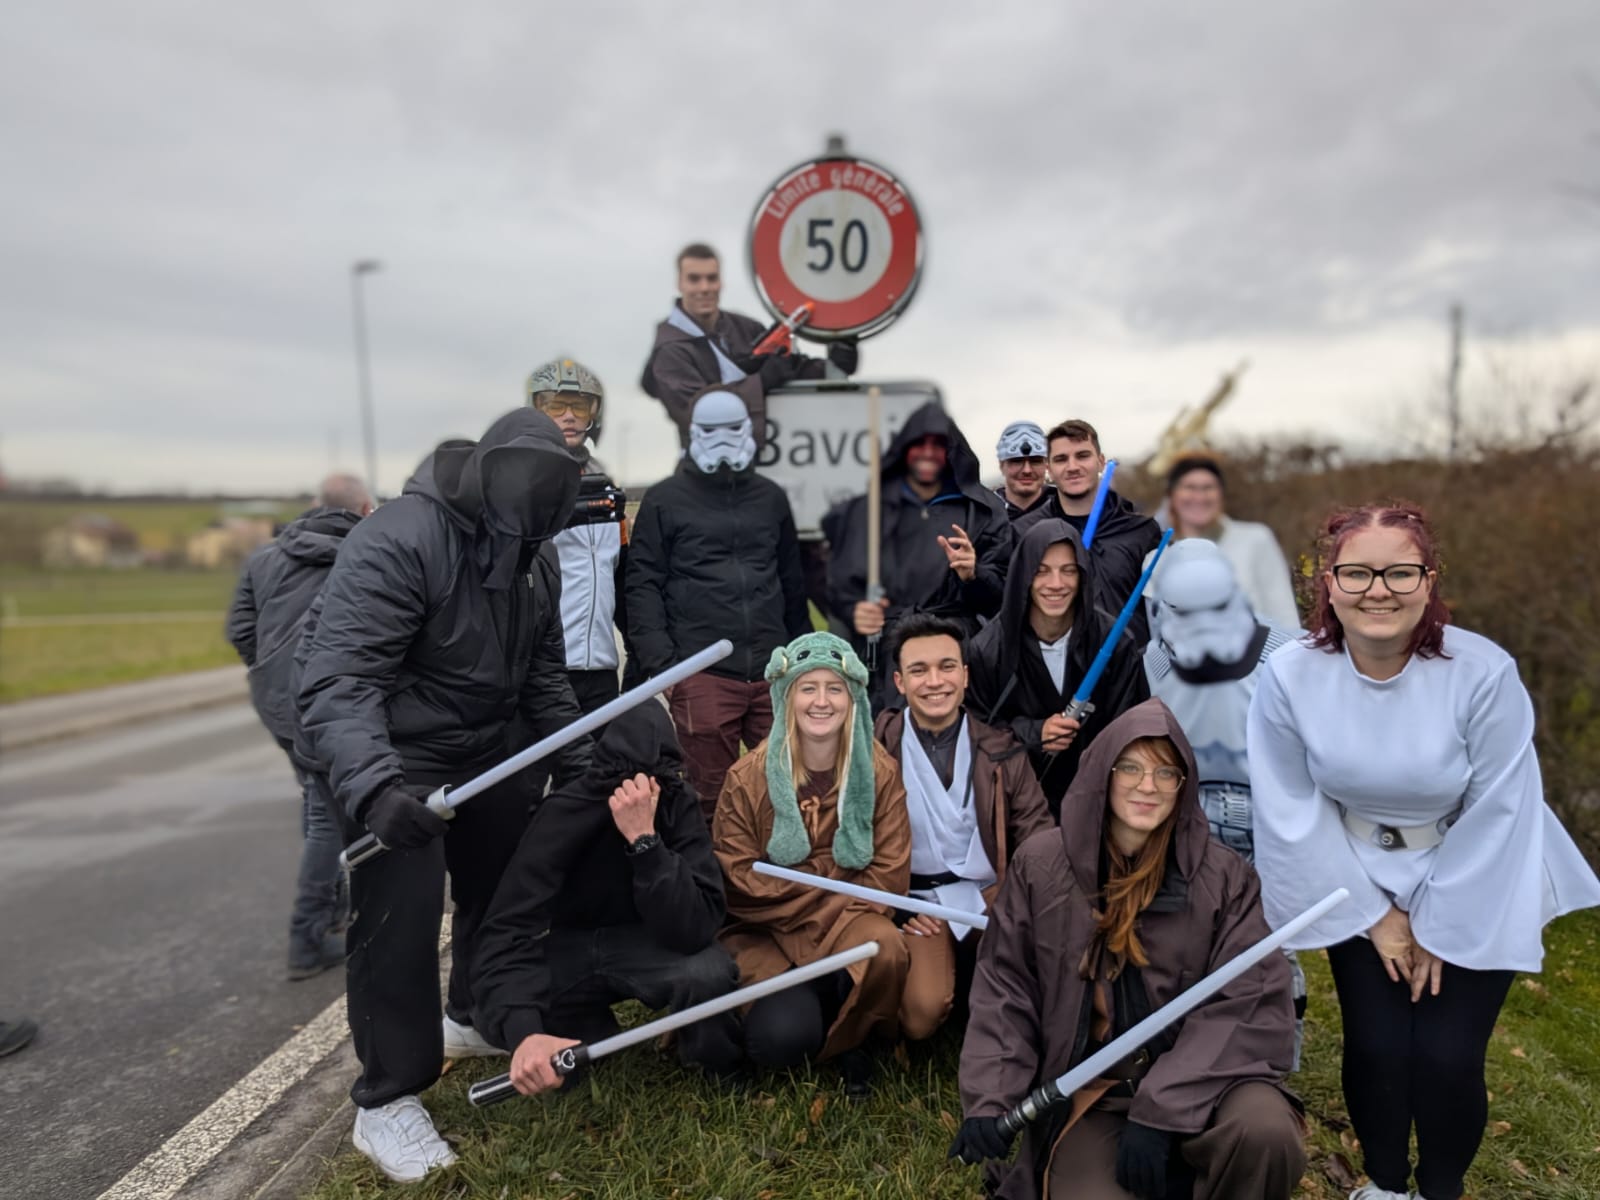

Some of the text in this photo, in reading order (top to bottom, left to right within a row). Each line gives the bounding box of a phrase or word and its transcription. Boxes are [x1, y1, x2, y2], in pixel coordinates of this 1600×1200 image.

[767, 166, 904, 219] Limite générale
[807, 218, 868, 273] 50
